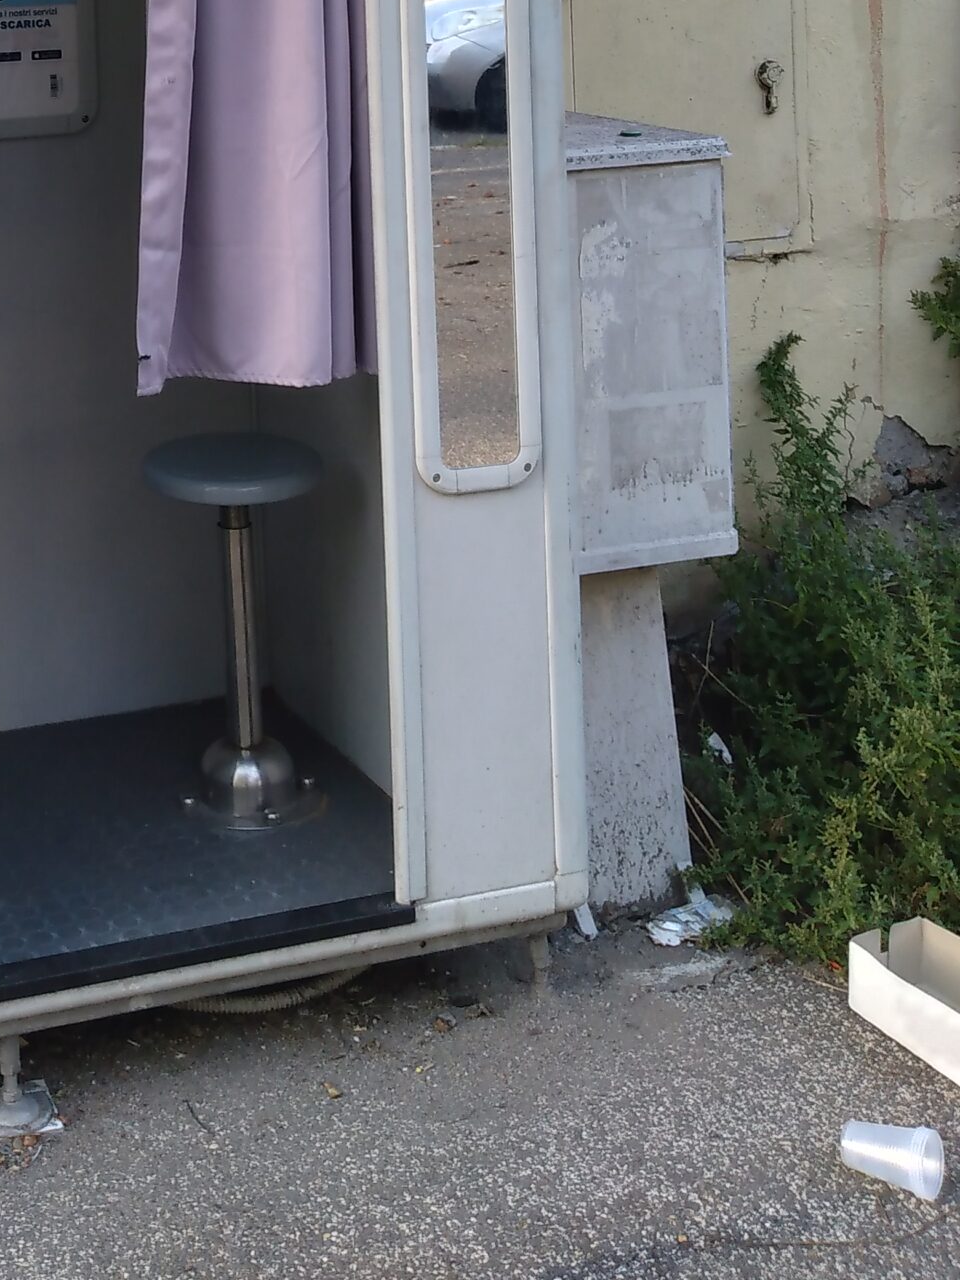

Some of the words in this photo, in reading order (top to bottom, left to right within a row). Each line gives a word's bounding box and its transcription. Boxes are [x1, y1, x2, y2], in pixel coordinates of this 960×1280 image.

[9, 8, 31, 17] nostri
[33, 7, 58, 17] servizi
[0, 19, 51, 30] SCARICA
